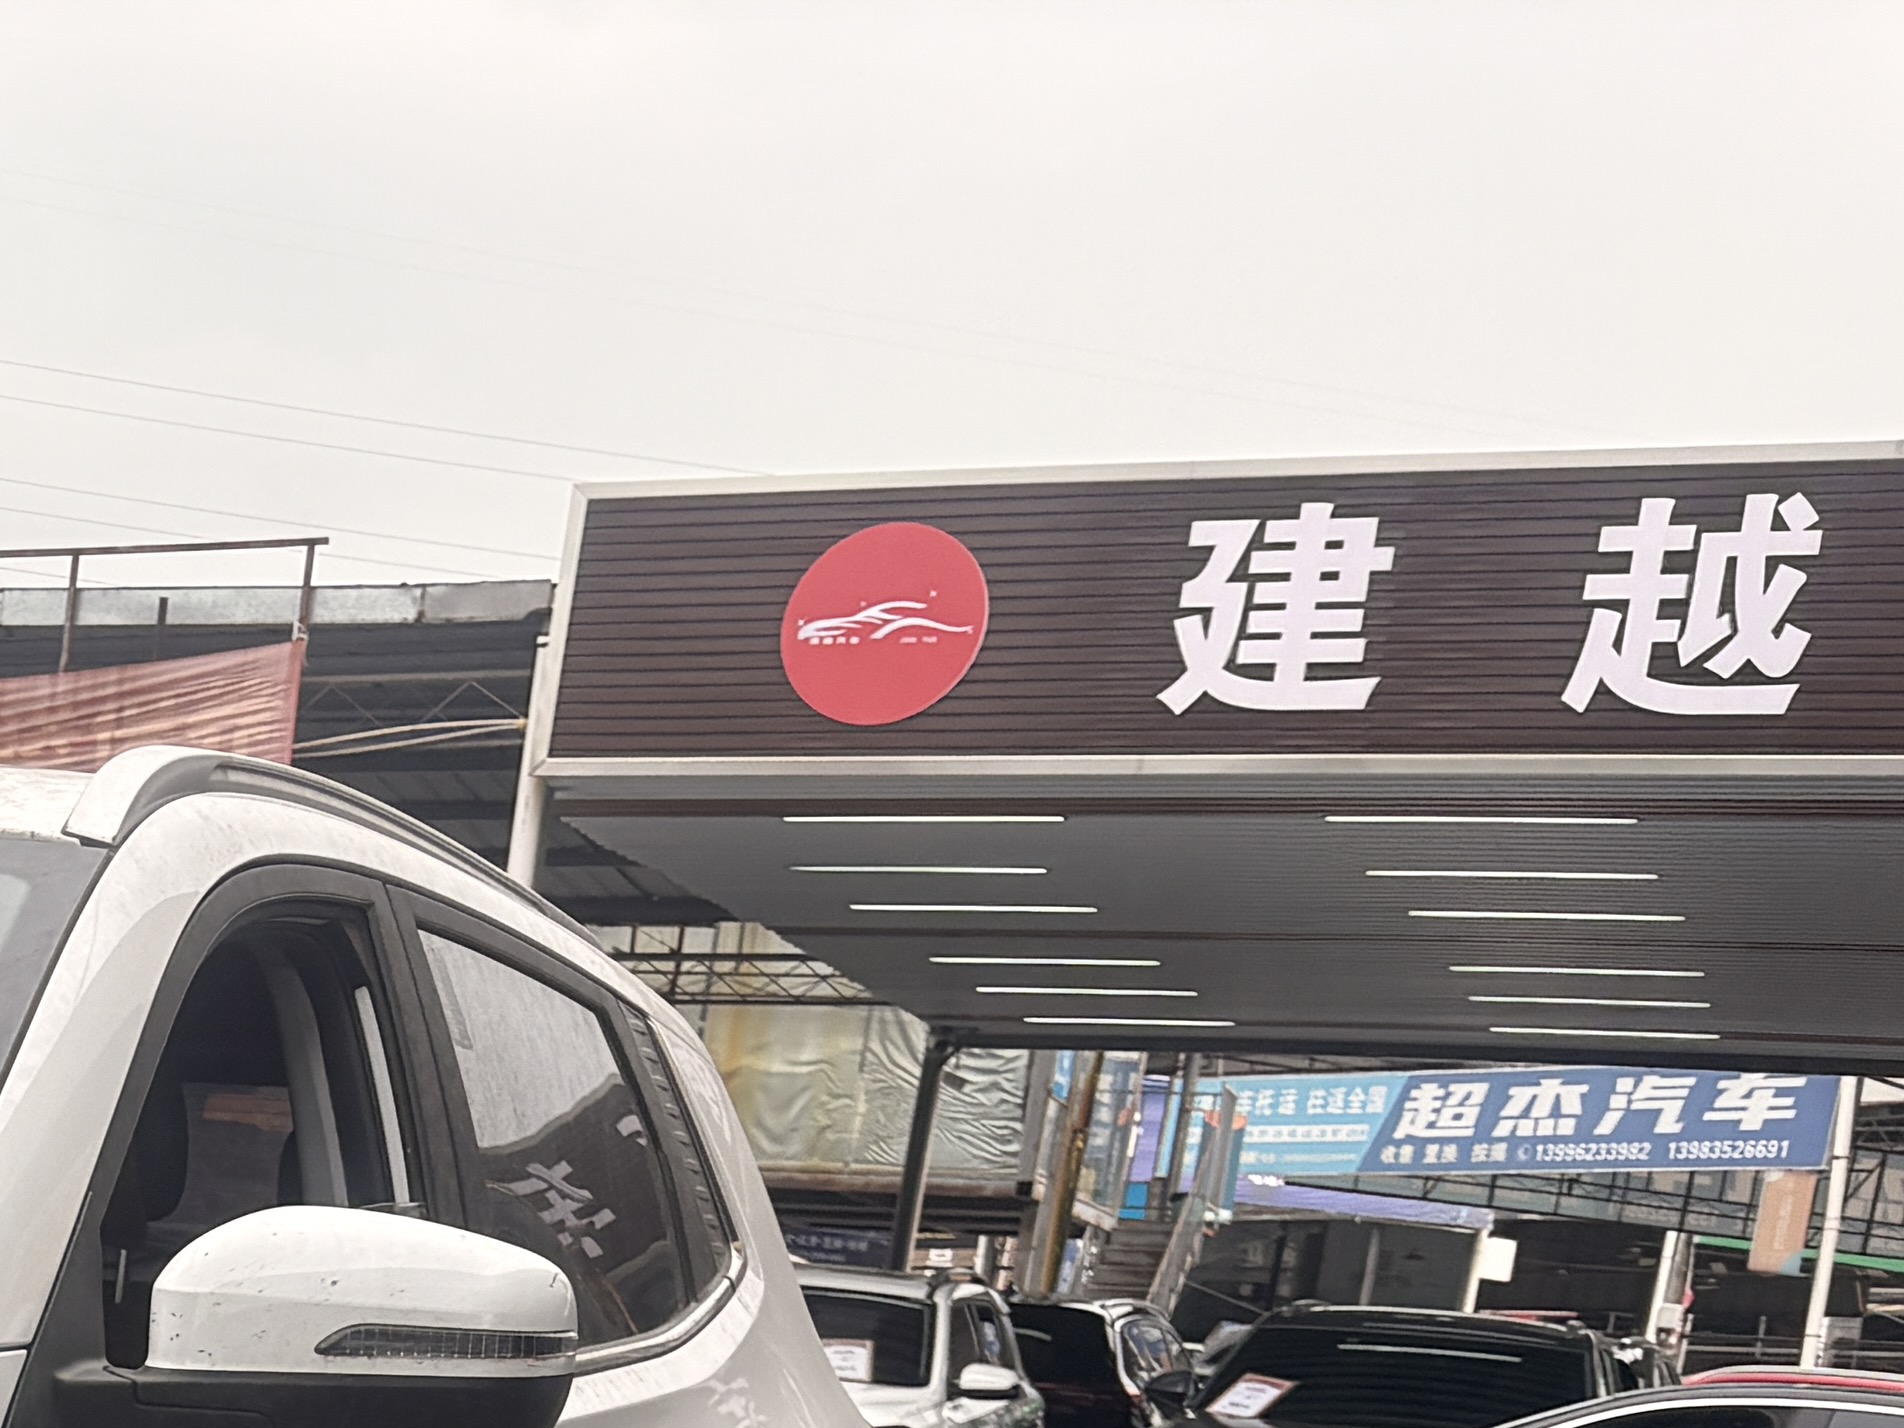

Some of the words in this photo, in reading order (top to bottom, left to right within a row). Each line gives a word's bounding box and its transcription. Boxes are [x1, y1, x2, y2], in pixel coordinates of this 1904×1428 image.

[1158, 492, 1824, 716] 建越
[1392, 1073, 1808, 1139] 超杰汽车
